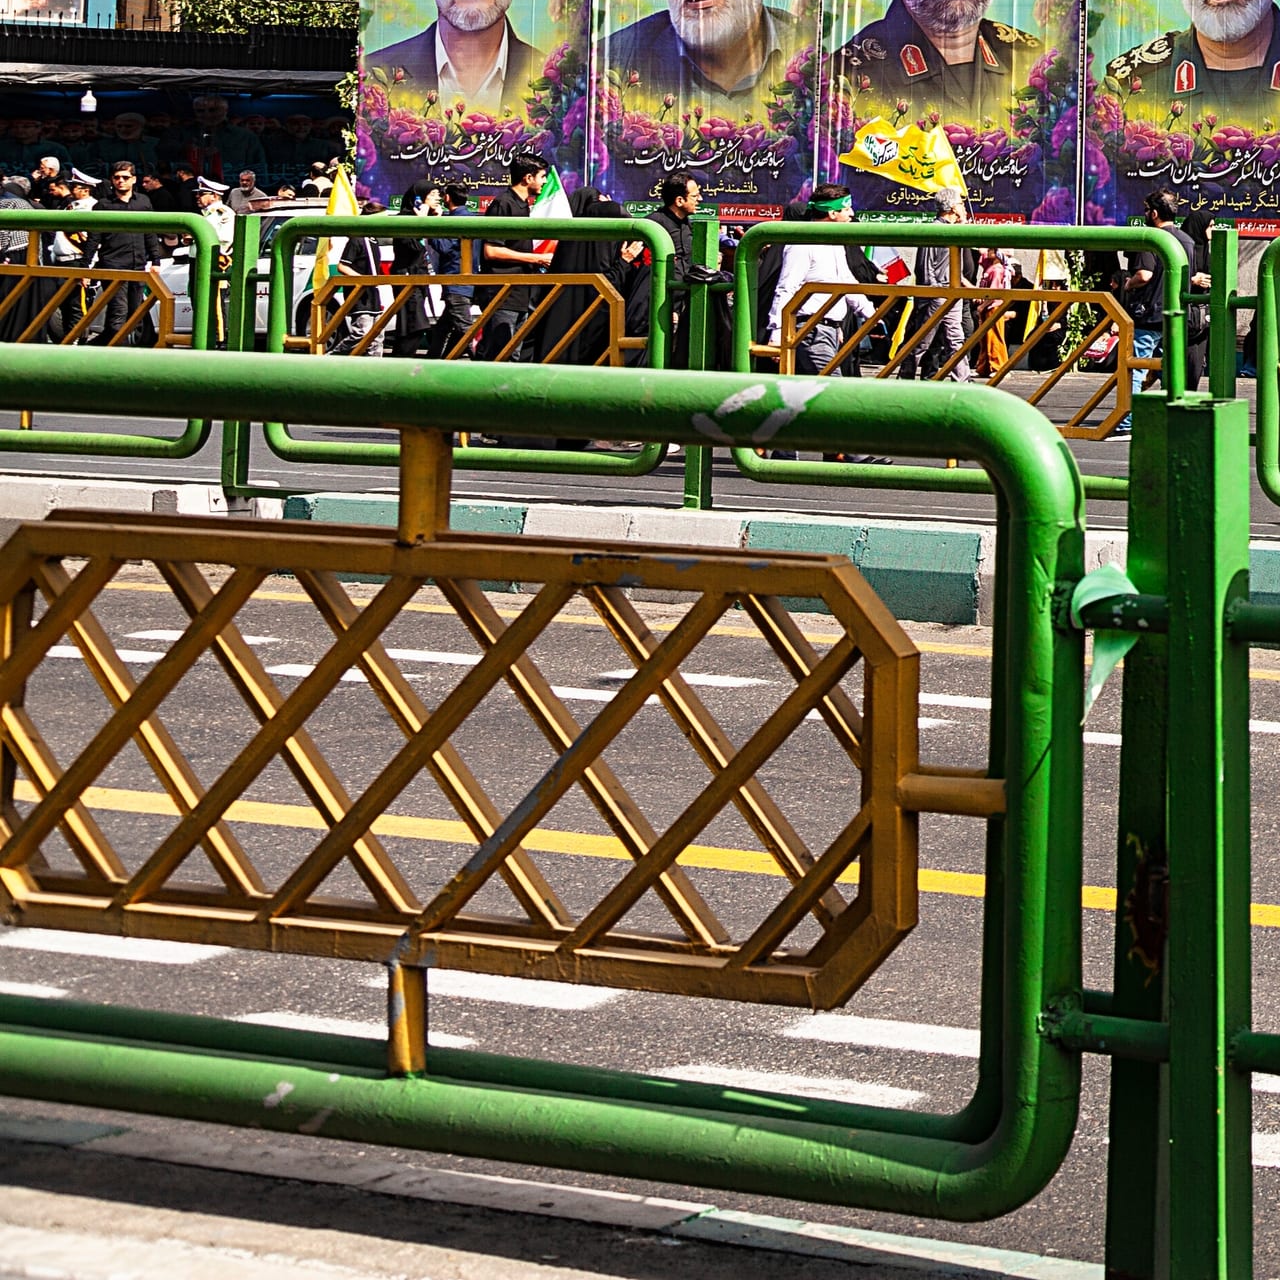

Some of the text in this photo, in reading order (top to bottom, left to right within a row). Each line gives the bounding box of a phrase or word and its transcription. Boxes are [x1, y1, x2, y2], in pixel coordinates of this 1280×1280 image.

[427, 133, 488, 170] شهیدان
[716, 138, 742, 174] لشکر
[743, 150, 770, 173] مهدی
[768, 152, 785, 179] سپاه
[983, 157, 1011, 181] مهدی
[1010, 158, 1028, 187] سپاه
[1171, 148, 1244, 190] شهیدان
[1233, 147, 1262, 187] لشکر
[703, 179, 725, 197] شهید
[725, 180, 758, 194] دانشمند
[758, 206, 781, 219] شهادت
[1190, 193, 1209, 210] علی
[1211, 193, 1227, 211] امیر
[1228, 192, 1252, 211] شهید
